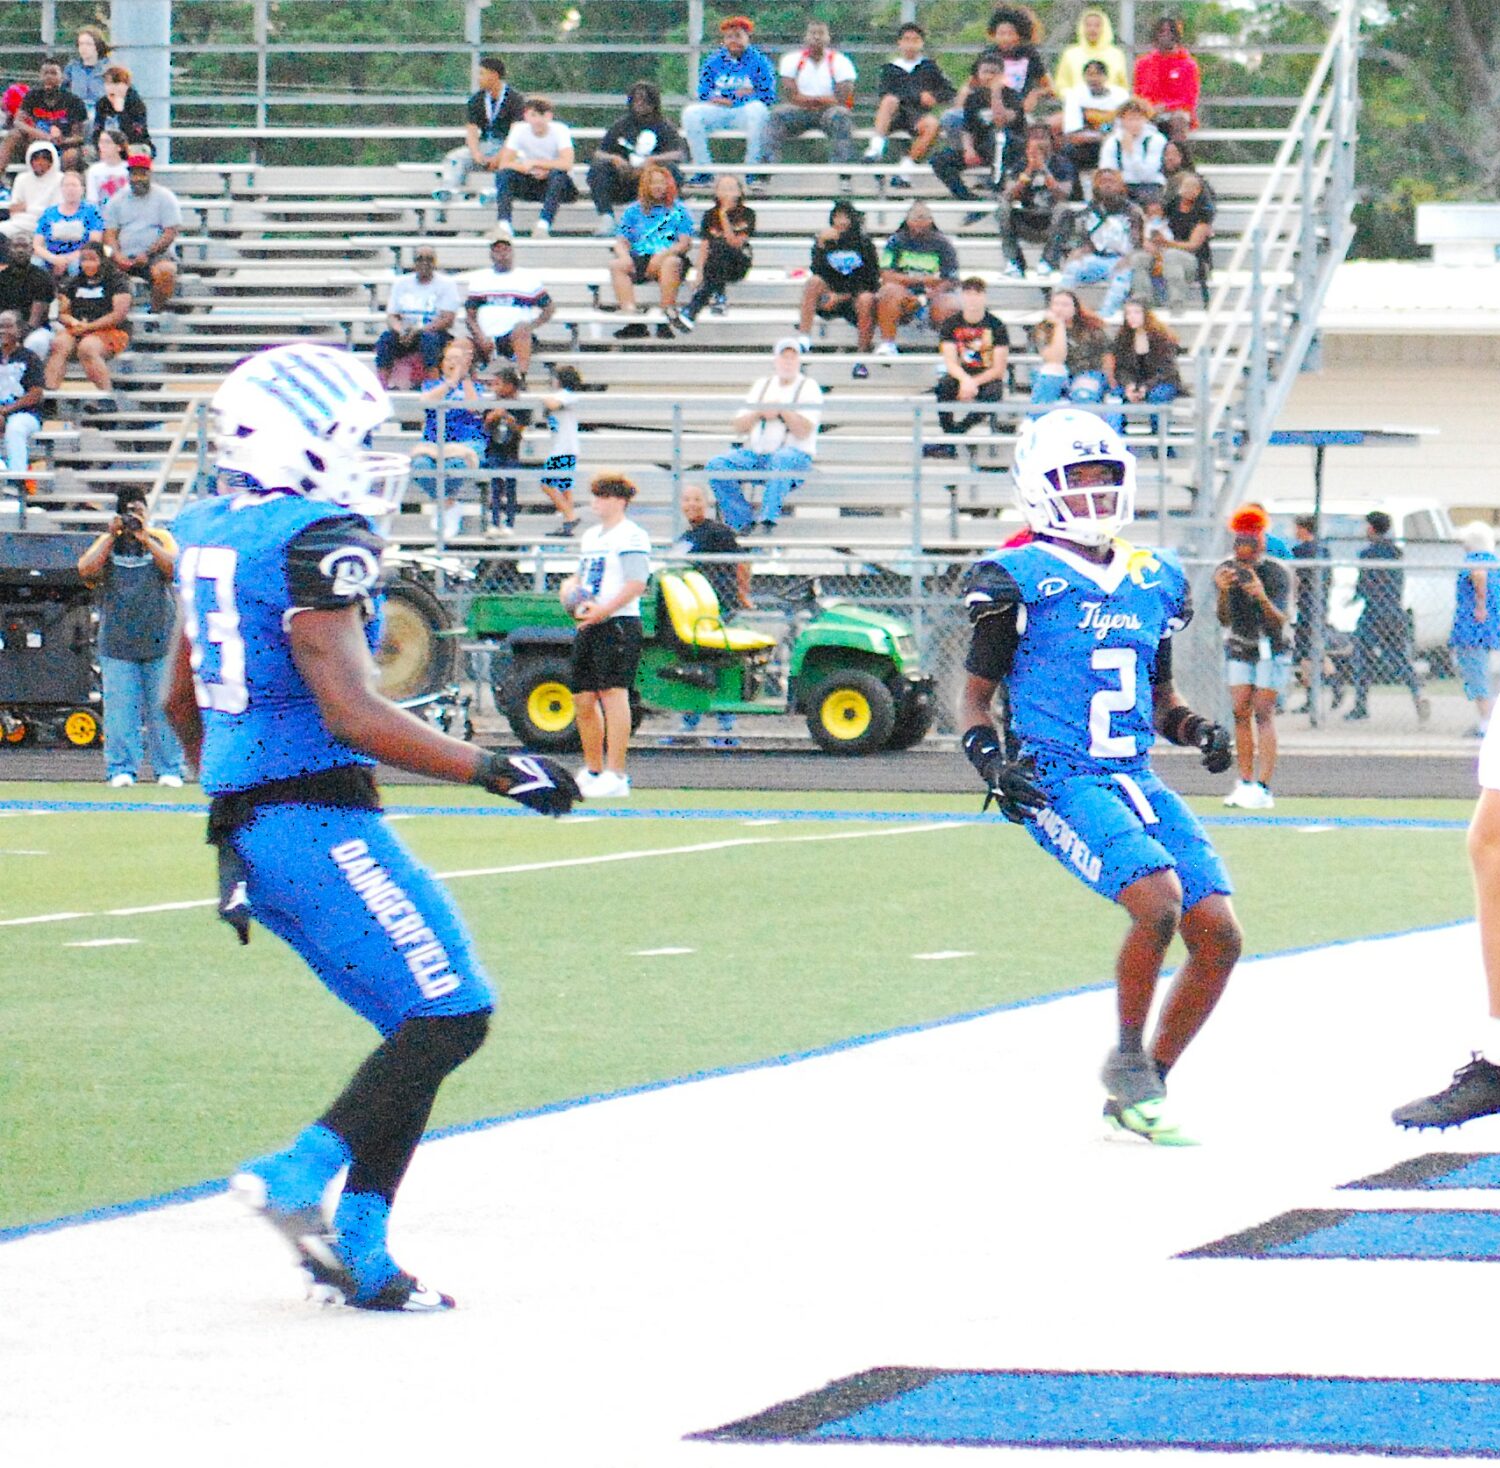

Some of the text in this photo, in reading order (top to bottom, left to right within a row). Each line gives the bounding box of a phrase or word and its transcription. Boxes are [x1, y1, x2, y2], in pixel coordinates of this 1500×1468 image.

[1077, 601, 1142, 640] Tigers
[1089, 648, 1138, 758] 2
[330, 839, 462, 1000] DAINGERFIELD
